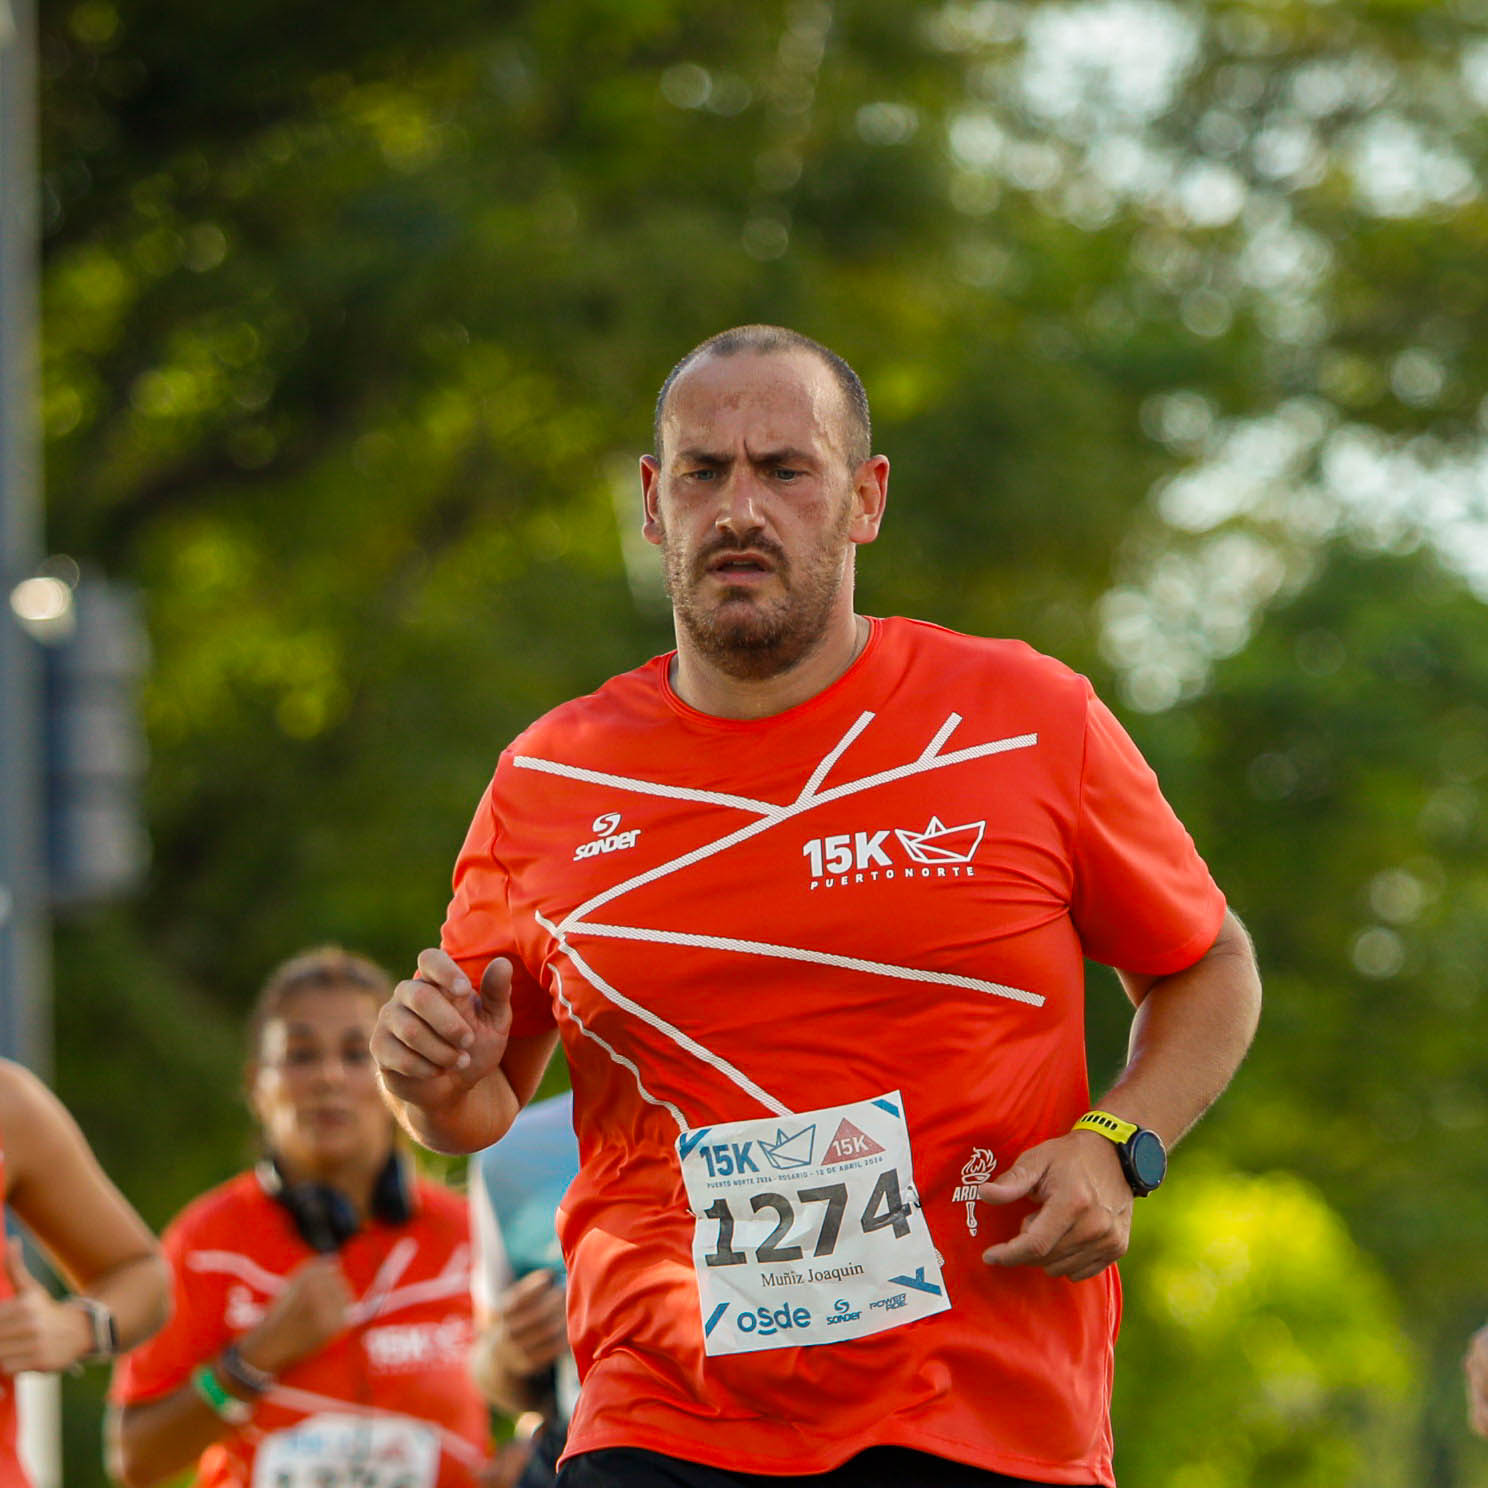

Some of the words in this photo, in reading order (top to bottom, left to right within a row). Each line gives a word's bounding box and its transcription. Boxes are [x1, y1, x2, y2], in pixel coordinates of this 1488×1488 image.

[802, 830, 894, 878] 15K
[810, 869, 894, 890] PUERTO
[904, 866, 975, 878] NORTE
[699, 1141, 760, 1178] 15K
[832, 1134, 869, 1157] 15K
[707, 1179, 732, 1189] PUERTO
[733, 1177, 754, 1186] NORTE
[778, 1171, 808, 1181] ROSARIO
[839, 1162, 862, 1172] ABRIL
[704, 1168, 912, 1267] 1274
[761, 1270, 805, 1288] Muñiz
[807, 1262, 864, 1284] Joaquin
[737, 1302, 811, 1333] osde
